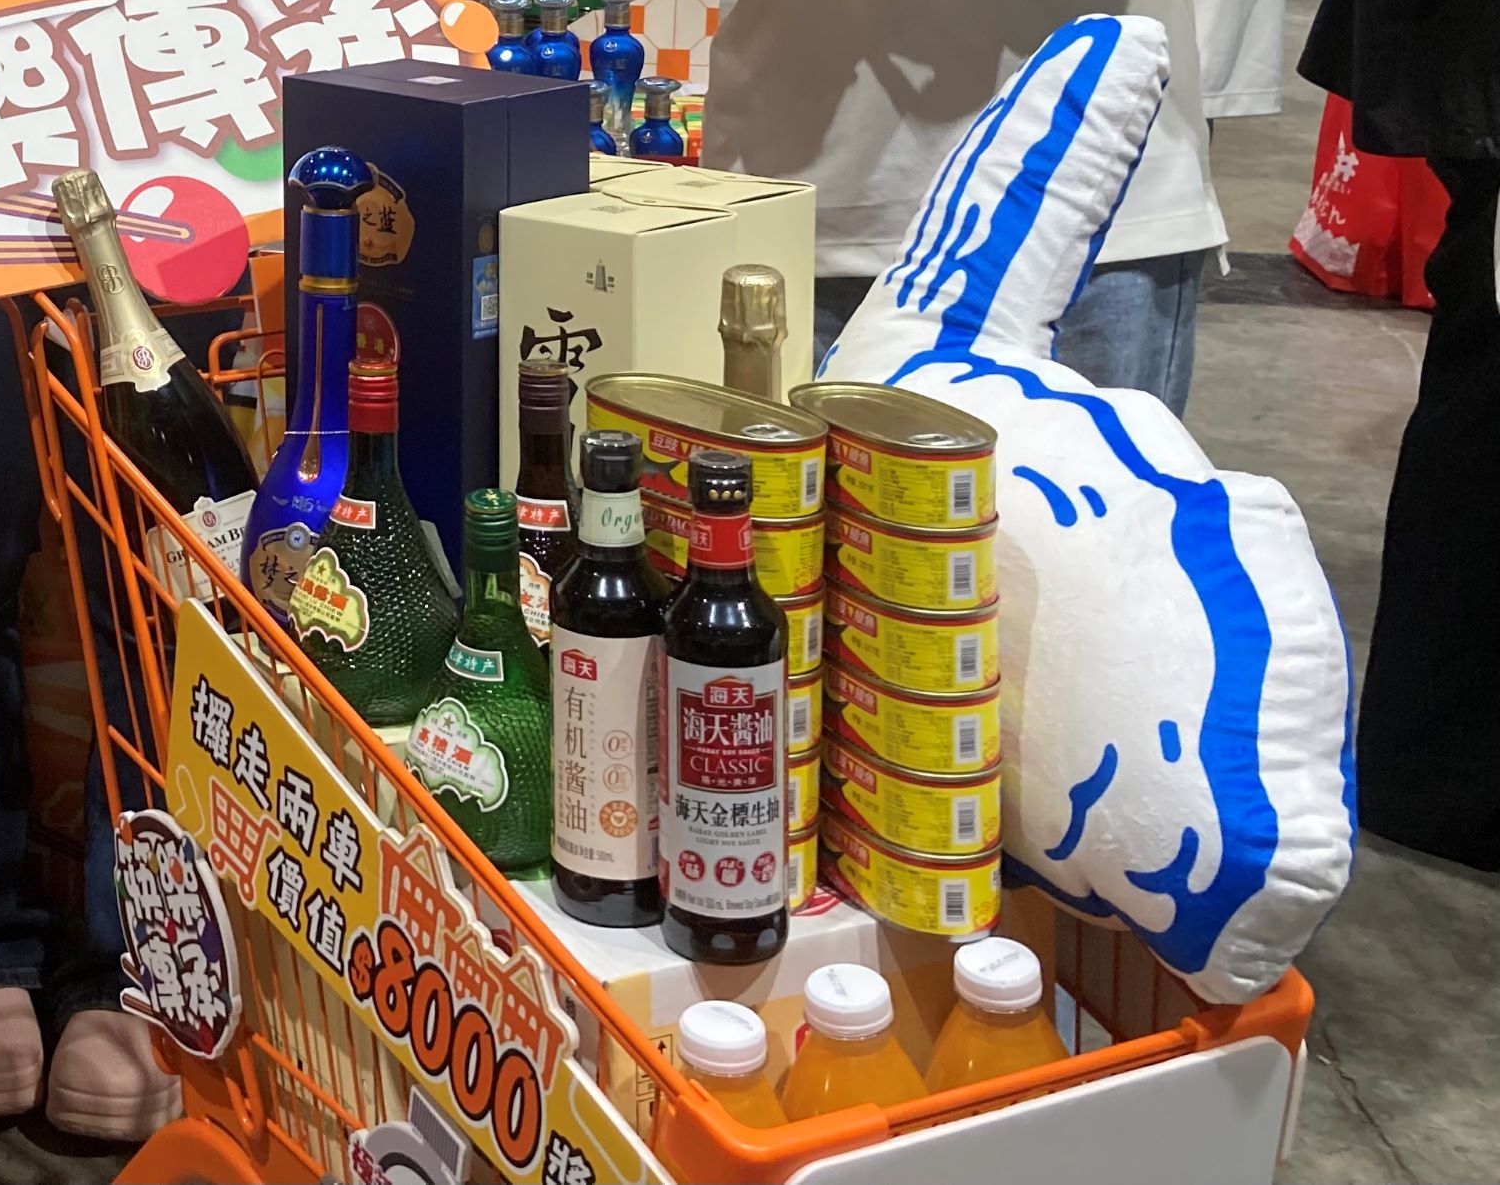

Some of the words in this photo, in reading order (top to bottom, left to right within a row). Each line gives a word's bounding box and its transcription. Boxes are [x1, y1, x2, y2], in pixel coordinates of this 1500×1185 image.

[709, 685, 750, 705] 海天
[190, 674, 364, 901] 攞走兩車
[563, 685, 588, 835] 有机酱油
[689, 754, 768, 775] CLASSIC
[675, 792, 781, 828] 海天金標生抽
[266, 851, 347, 976] 價值
[347, 918, 544, 1169] $8000
